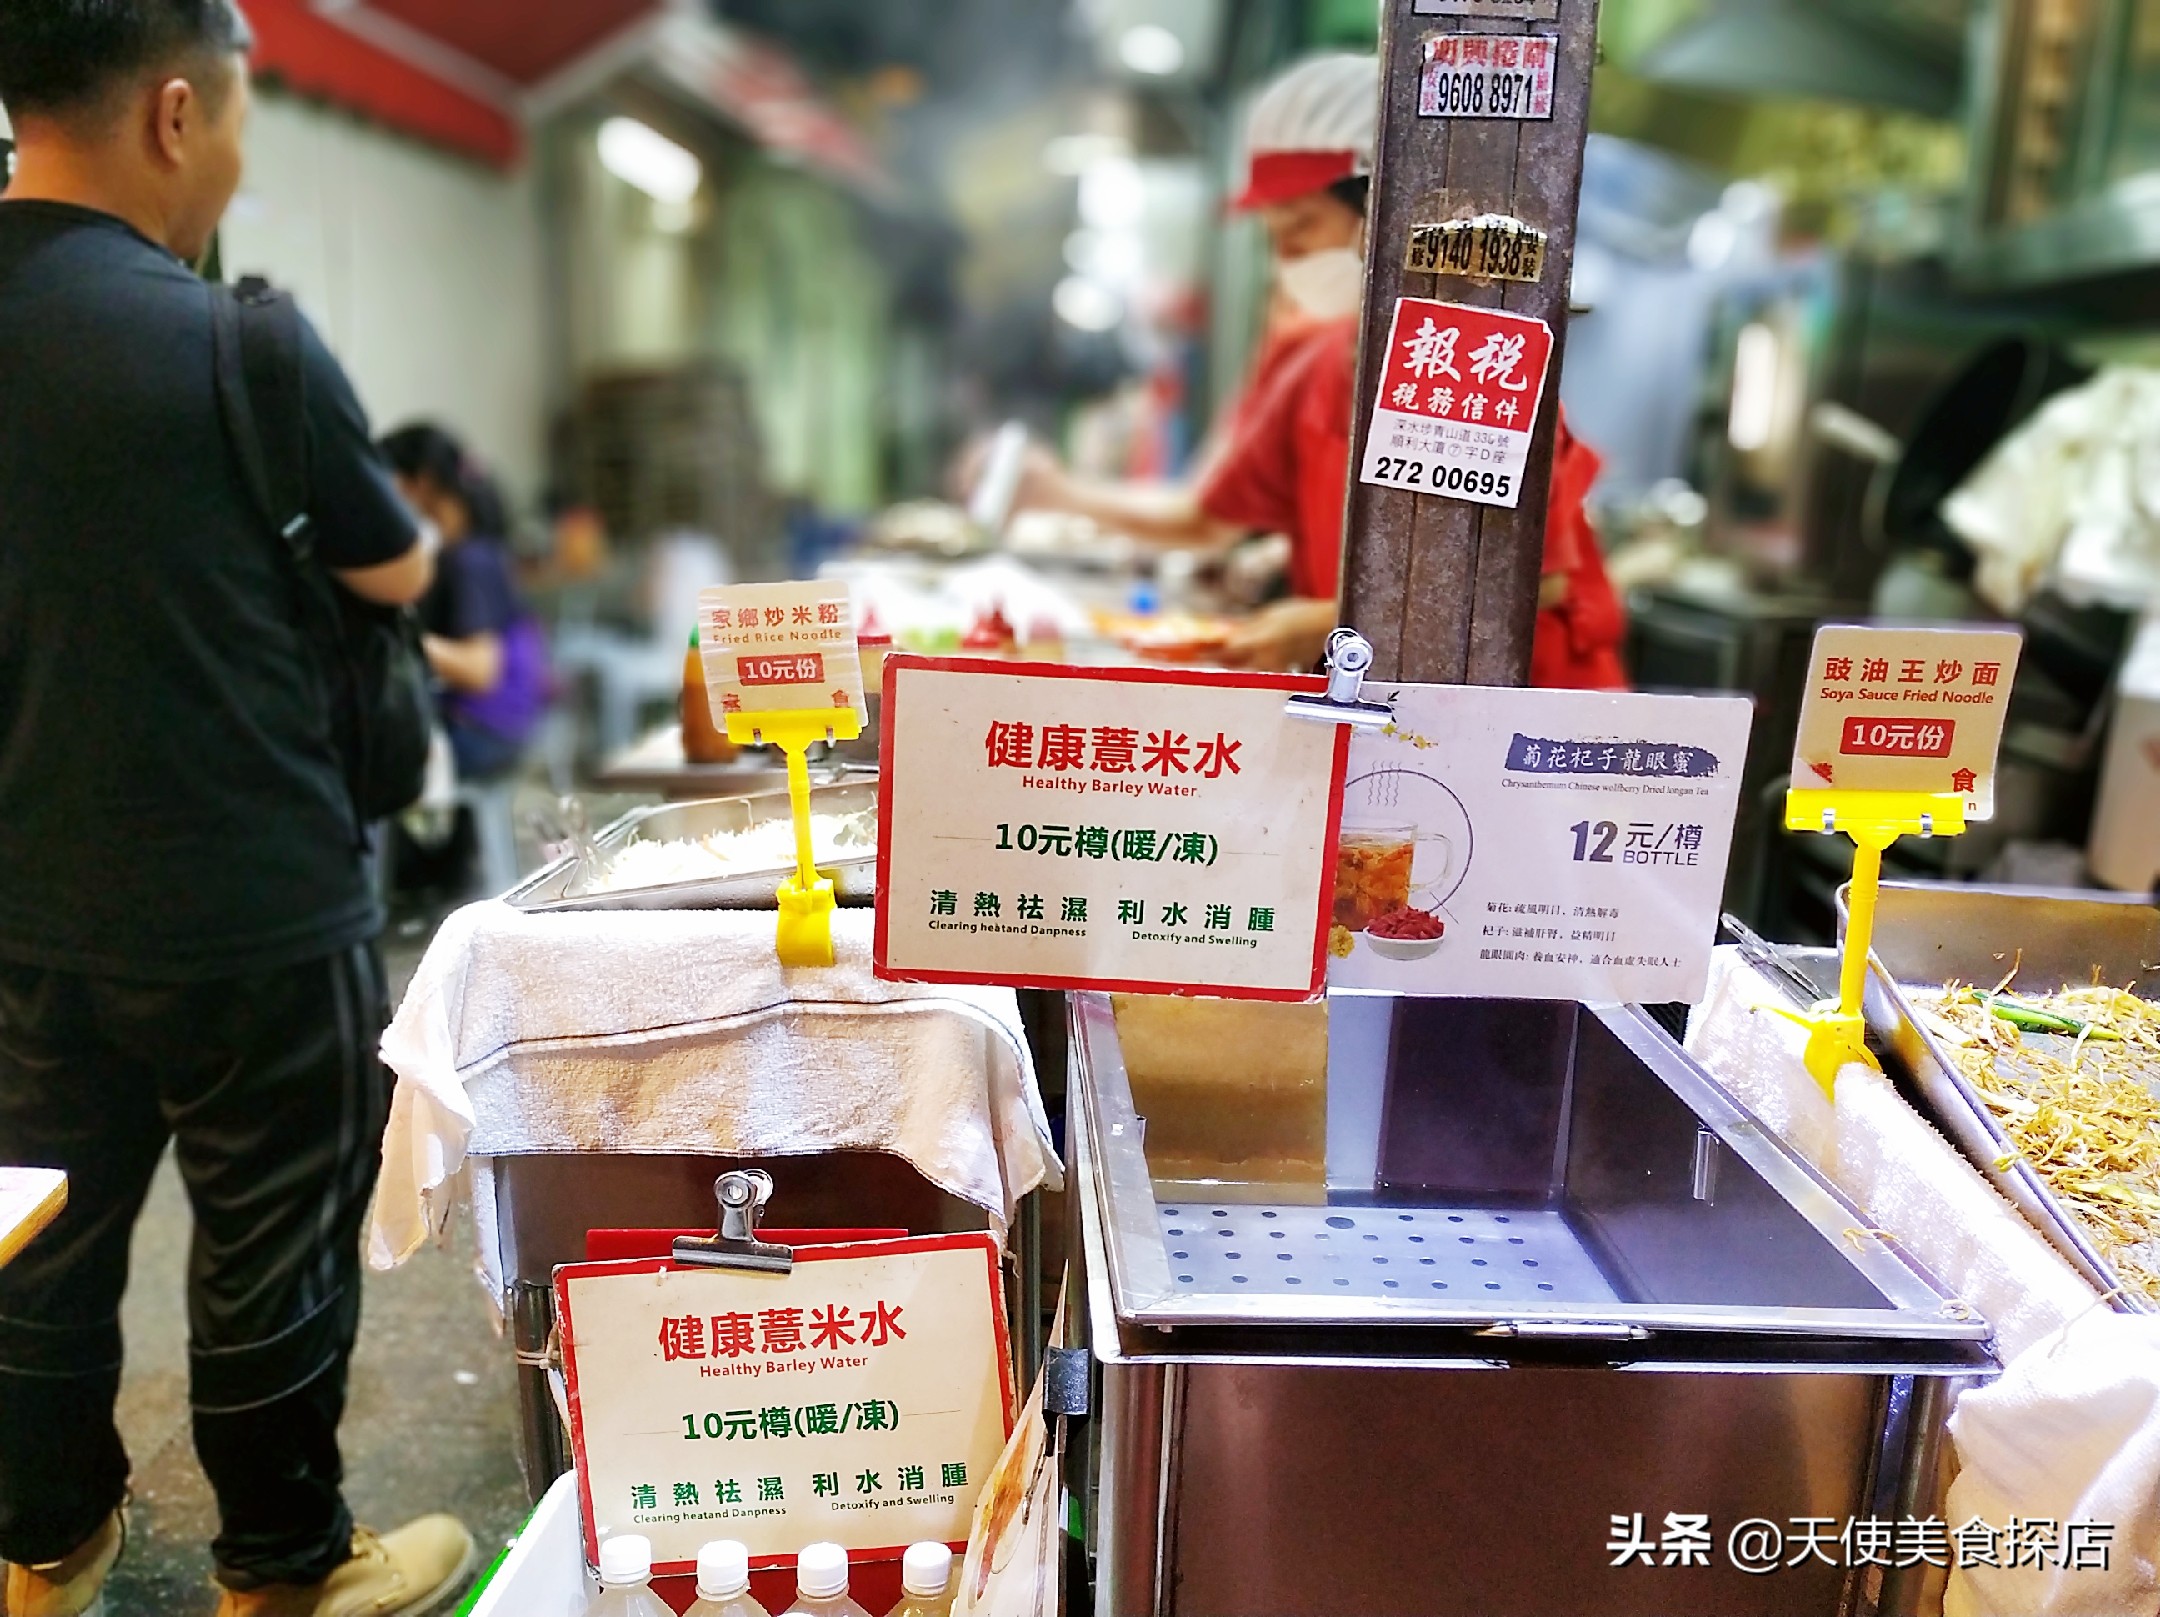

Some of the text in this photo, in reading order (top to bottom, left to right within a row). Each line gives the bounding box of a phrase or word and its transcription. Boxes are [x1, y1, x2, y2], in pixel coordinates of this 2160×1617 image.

[1438, 72, 1484, 113] 9608
[1489, 73, 1534, 114] 8971
[1375, 457, 1512, 498] 272 00695
[712, 603, 839, 630] 家鄉炒米粉
[755, 632, 784, 642] Rice
[790, 628, 842, 640] Noodle
[745, 658, 818, 681] 10元份
[1823, 656, 2001, 687] 豉油王炒面
[1820, 688, 1994, 704] Soya Sauce Fried Noodle
[984, 719, 1243, 780] 健康薏米水
[1851, 724, 1945, 751] 10元份
[1522, 743, 1695, 775] 菊花杞子龍眼蜜
[1021, 775, 1087, 794] Healthy
[1092, 779, 1144, 797] Barley
[1568, 781, 1600, 792] Chinese
[1642, 785, 1665, 794] Dried
[994, 822, 1219, 867] 10元樽(暖/凍)
[1570, 820, 1619, 863] 12
[1623, 850, 1700, 866] BOTTLE
[928, 920, 979, 934] Clearing
[1117, 899, 1275, 932] 利水消腫
[1131, 930, 1258, 948] Detoxify and Swelling
[657, 1300, 907, 1361] 健康薏米水
[700, 1353, 869, 1379] Healthy Barley Water
[682, 1398, 900, 1441] 10元樽(暖/凍)
[812, 1461, 970, 1498] 利水消腫
[831, 1493, 955, 1512] Detoxify and Swelling
[633, 1511, 680, 1525] Clearing
